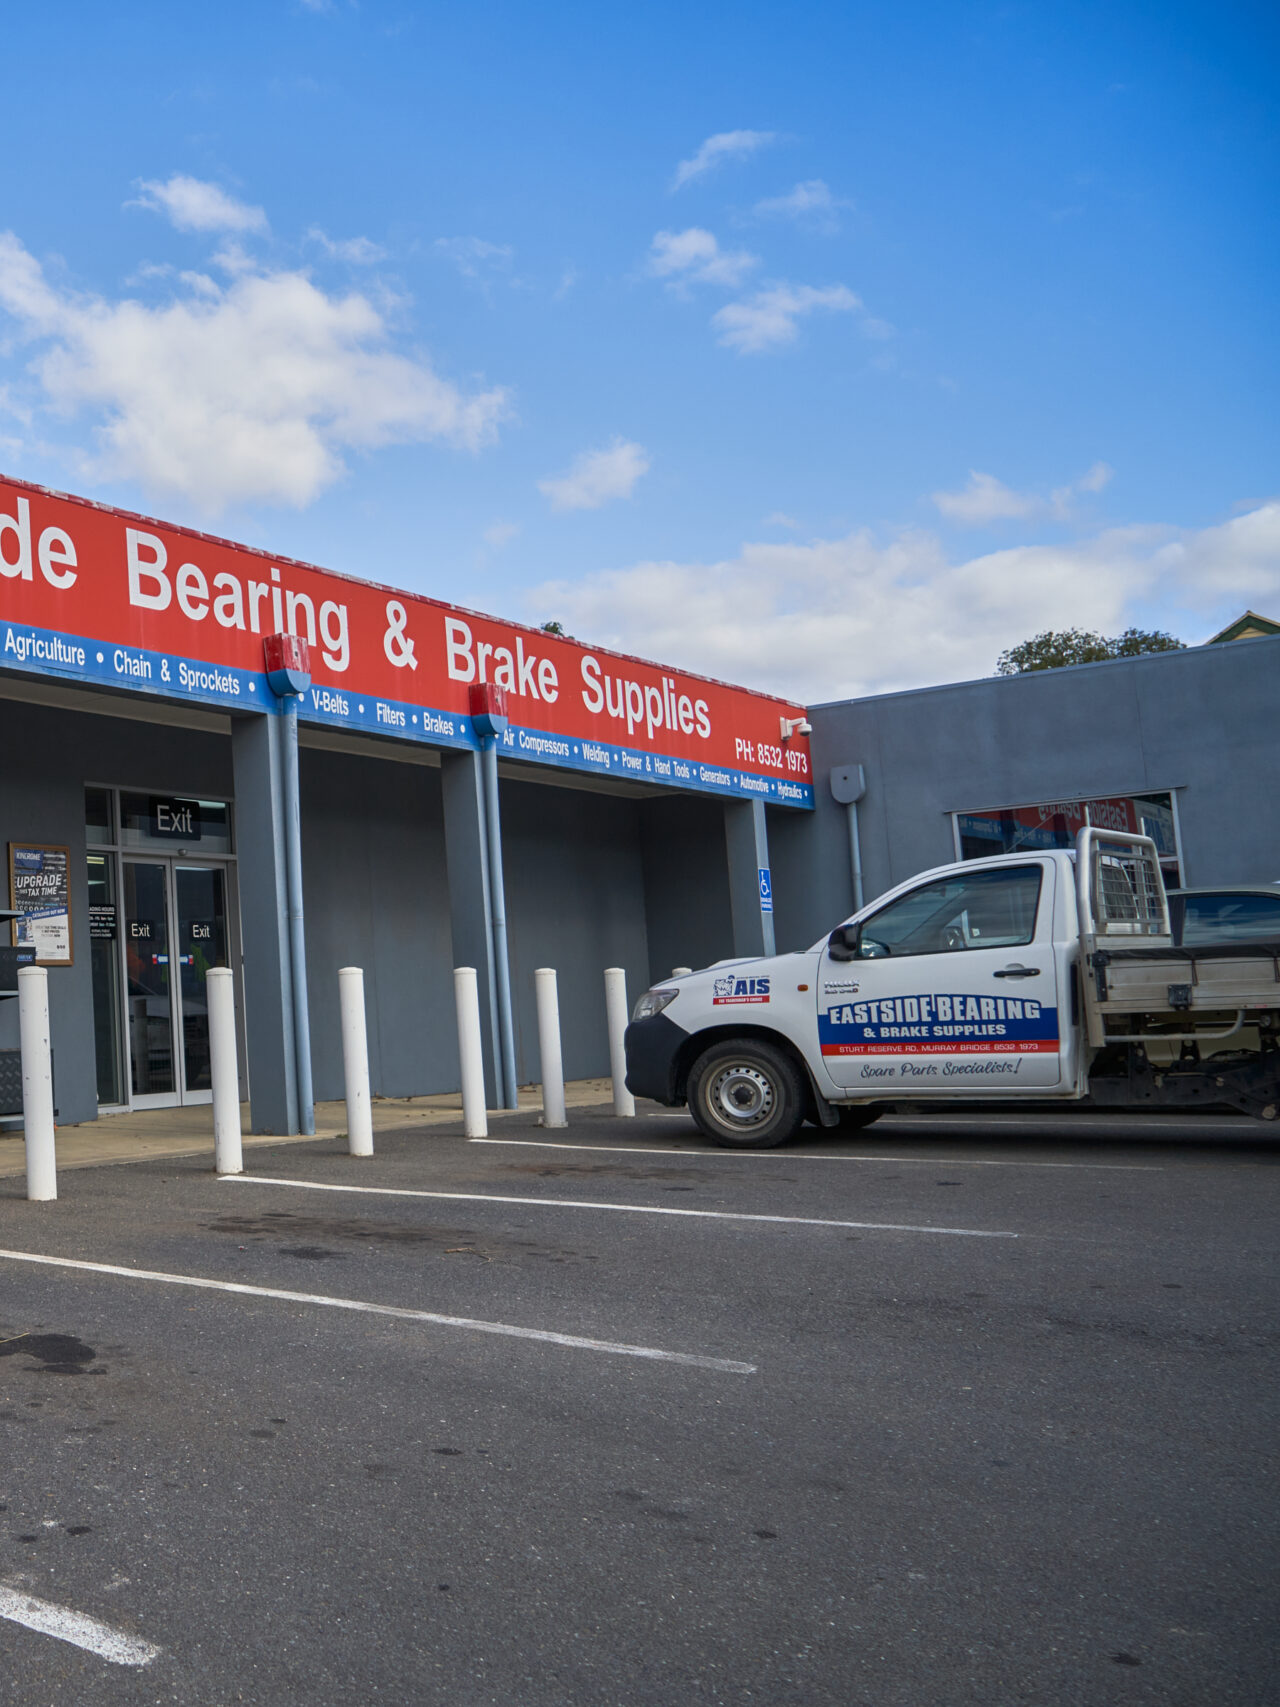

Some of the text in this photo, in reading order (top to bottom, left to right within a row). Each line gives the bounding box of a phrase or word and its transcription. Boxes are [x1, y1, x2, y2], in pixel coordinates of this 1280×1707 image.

[125, 527, 350, 672] Bearing
[383, 600, 418, 671] &
[444, 616, 559, 704] Brake
[580, 654, 712, 740] Supplies
[4, 628, 86, 667] Agriculture
[114, 650, 152, 680] Chain
[160, 659, 171, 683] &
[179, 663, 241, 696] Sprockets
[312, 688, 350, 717] V-Belts
[376, 702, 406, 727] Filters
[423, 710, 455, 736] Brakes
[503, 728, 515, 747] Air
[519, 730, 570, 757] Compressors
[582, 742, 611, 769] Welding
[622, 751, 643, 771] Power
[645, 756, 652, 772] &
[654, 757, 671, 776] Hand
[673, 760, 690, 779] Tools
[699, 765, 731, 787] Generators
[740, 775, 770, 794] Automotive
[777, 781, 803, 800] Hydraulics
[735, 738, 808, 774] PH: 8532 1973
[156, 804, 193, 834] Exit
[16, 874, 62, 889] UPGRADE
[28, 888, 40, 897] TAX
[41, 886, 58, 896] TIME
[131, 923, 151, 938] Exit
[192, 924, 211, 938] Exit
[734, 978, 770, 996] AIS
[829, 996, 1041, 1025] EASTSIDE BEARING
[863, 1024, 1007, 1038] & BRAKE SUPPLIES
[921, 1044, 957, 1052] MURRAY
[993, 1043, 1015, 1051] 8532
[860, 1058, 1023, 1079] Spare Parts Specialists!
